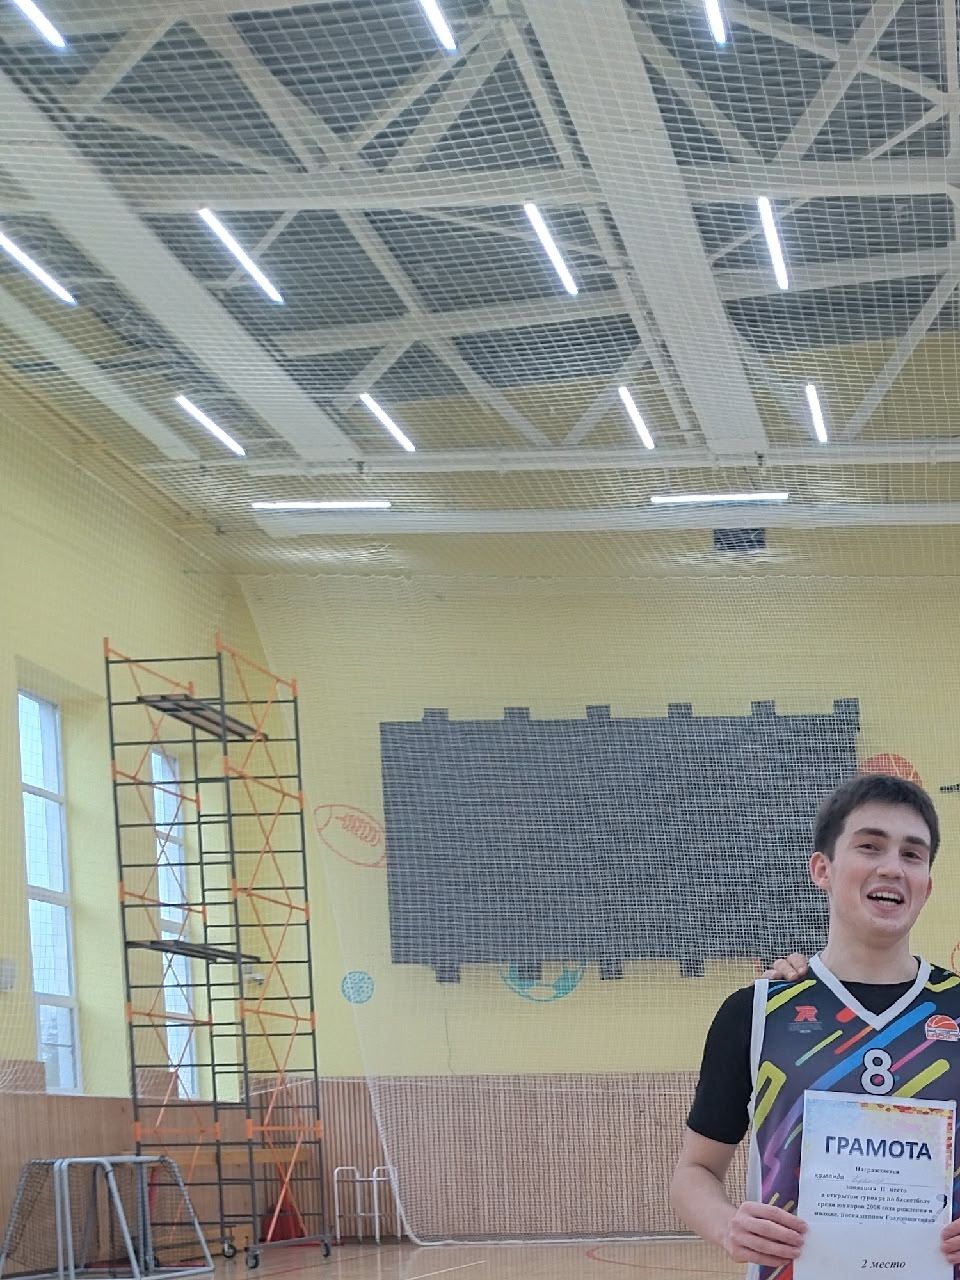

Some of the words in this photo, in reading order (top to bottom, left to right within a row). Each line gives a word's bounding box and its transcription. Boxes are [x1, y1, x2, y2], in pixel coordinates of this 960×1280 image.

[860, 1047, 896, 1095] 8
[825, 1135, 932, 1160] ГРАМОТА
[860, 1258, 868, 1268] 2
[869, 1261, 906, 1269] место
